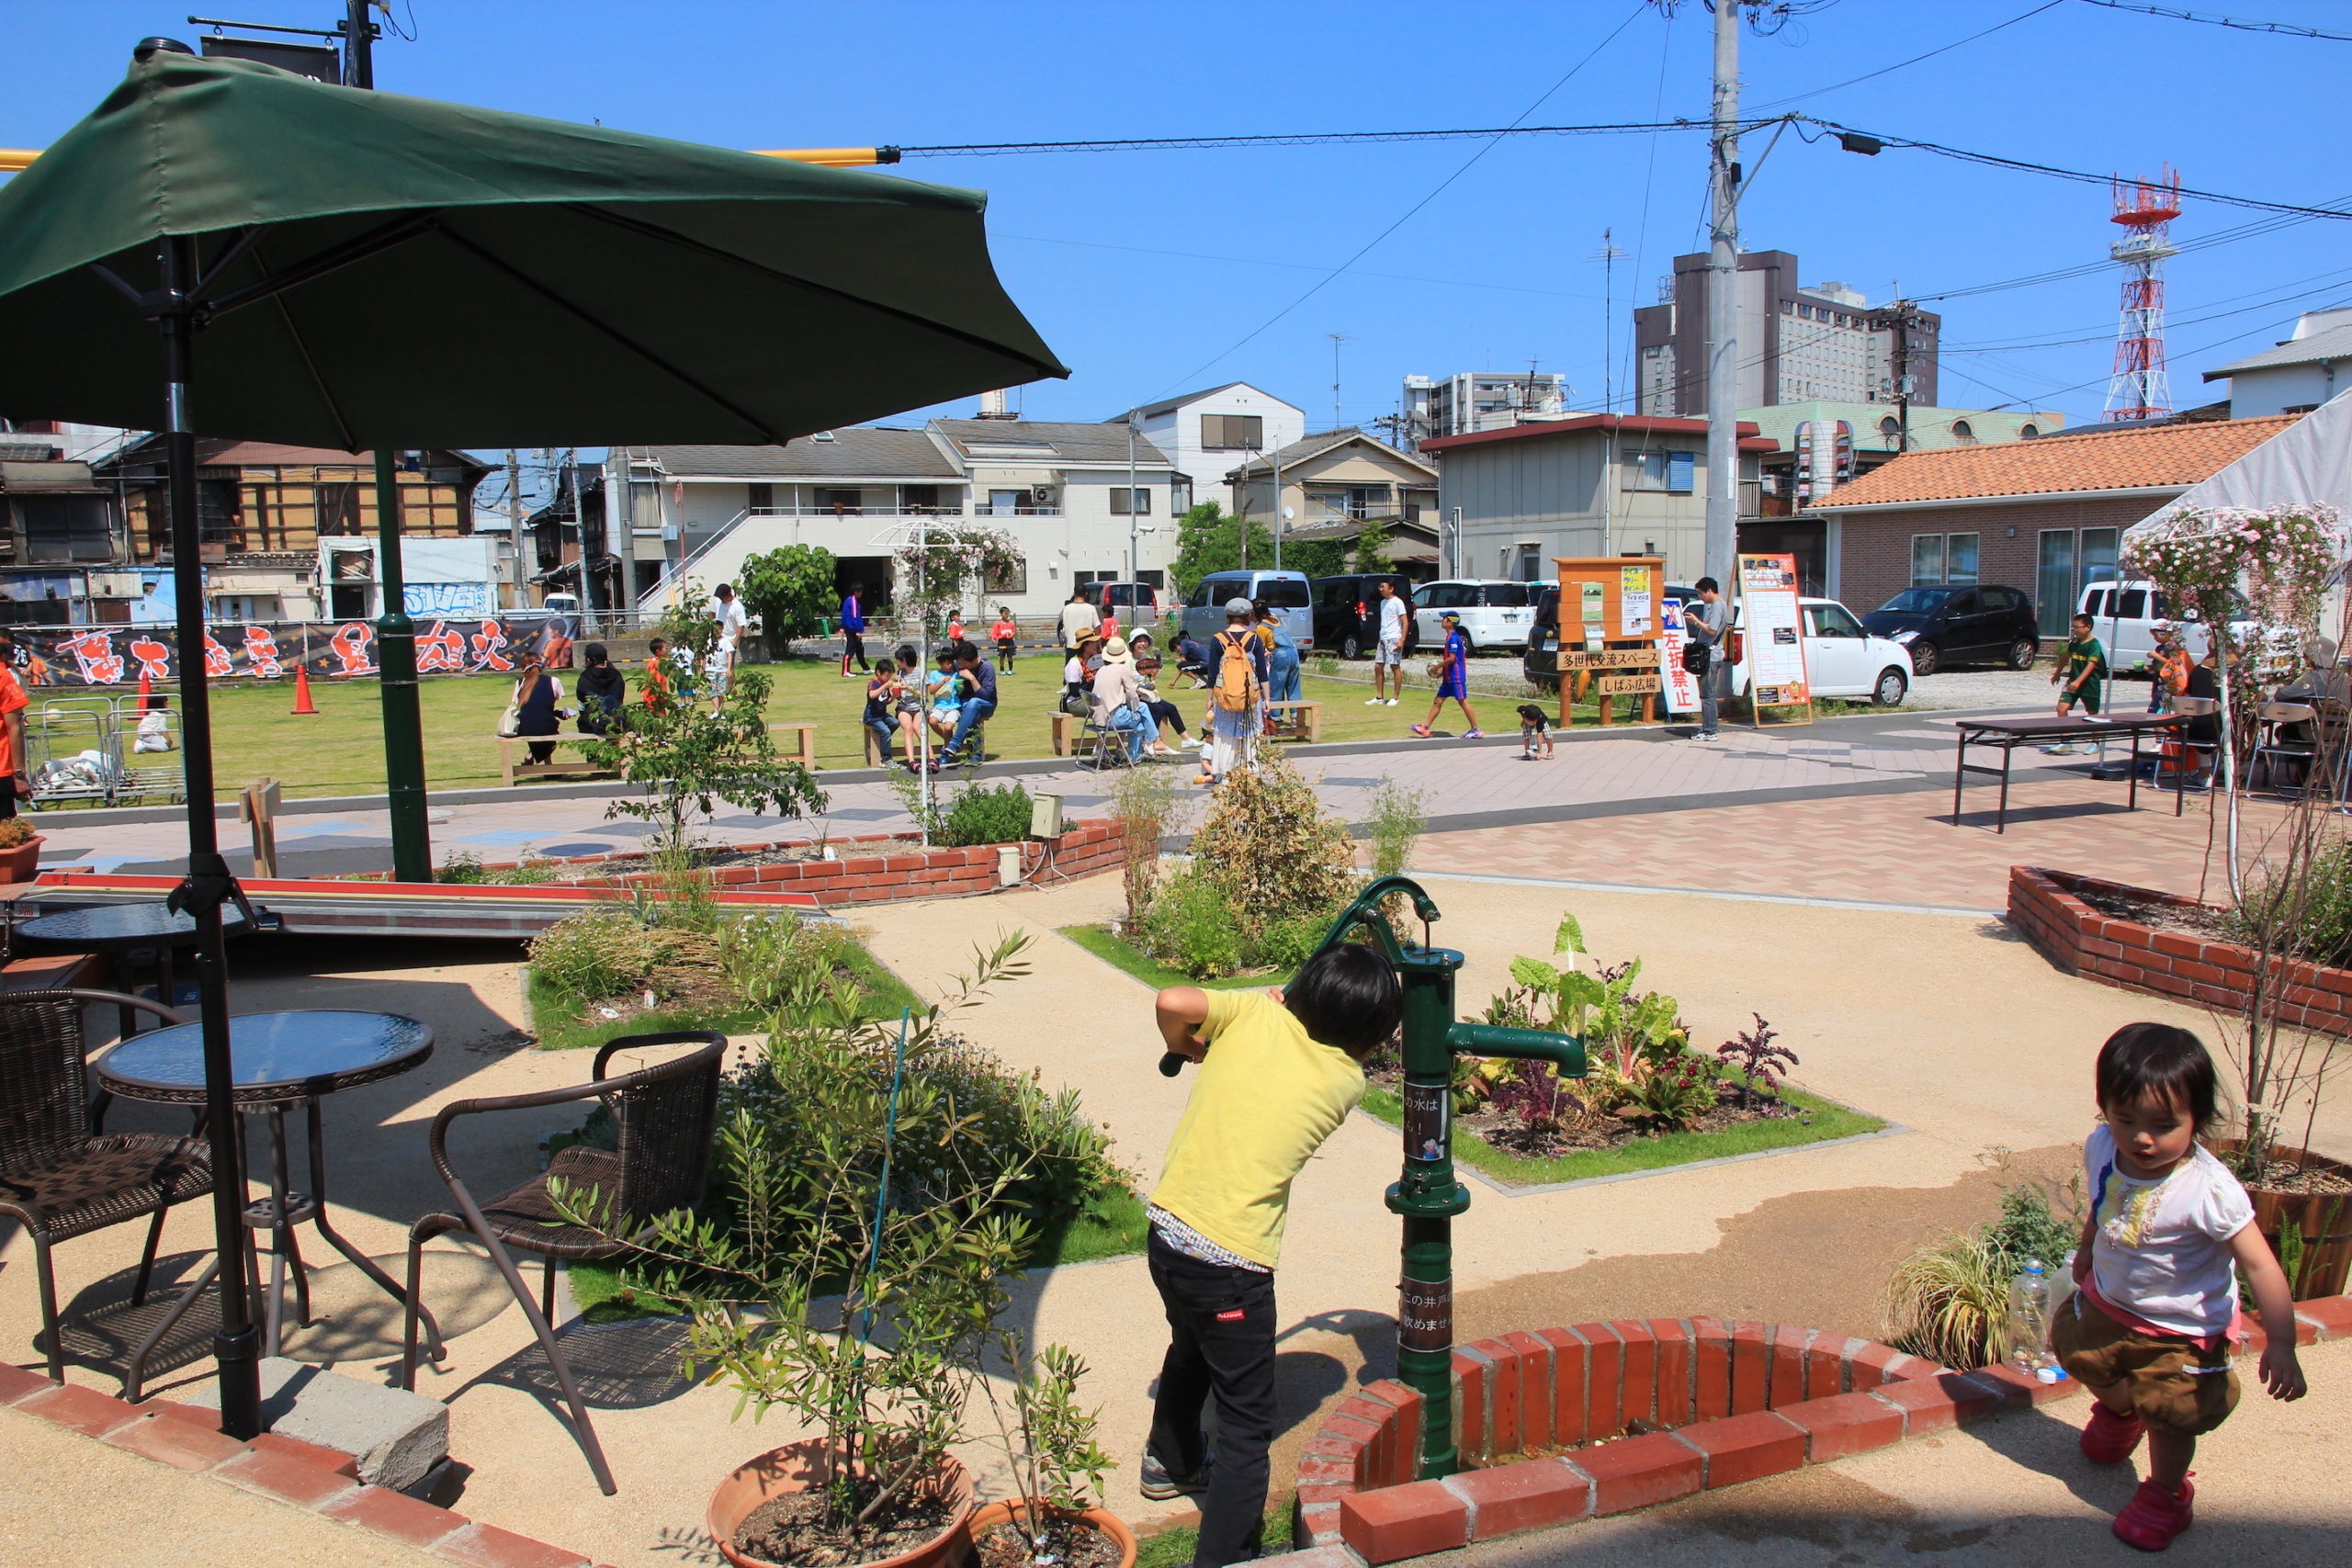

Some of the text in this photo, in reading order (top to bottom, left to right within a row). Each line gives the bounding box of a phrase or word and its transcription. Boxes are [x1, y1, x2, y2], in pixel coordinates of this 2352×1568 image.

[1563, 652, 1658, 669] 多世代交流スペース
[1663, 632, 1692, 707] 左折禁止
[1604, 677, 1656, 693] しばふ広場
